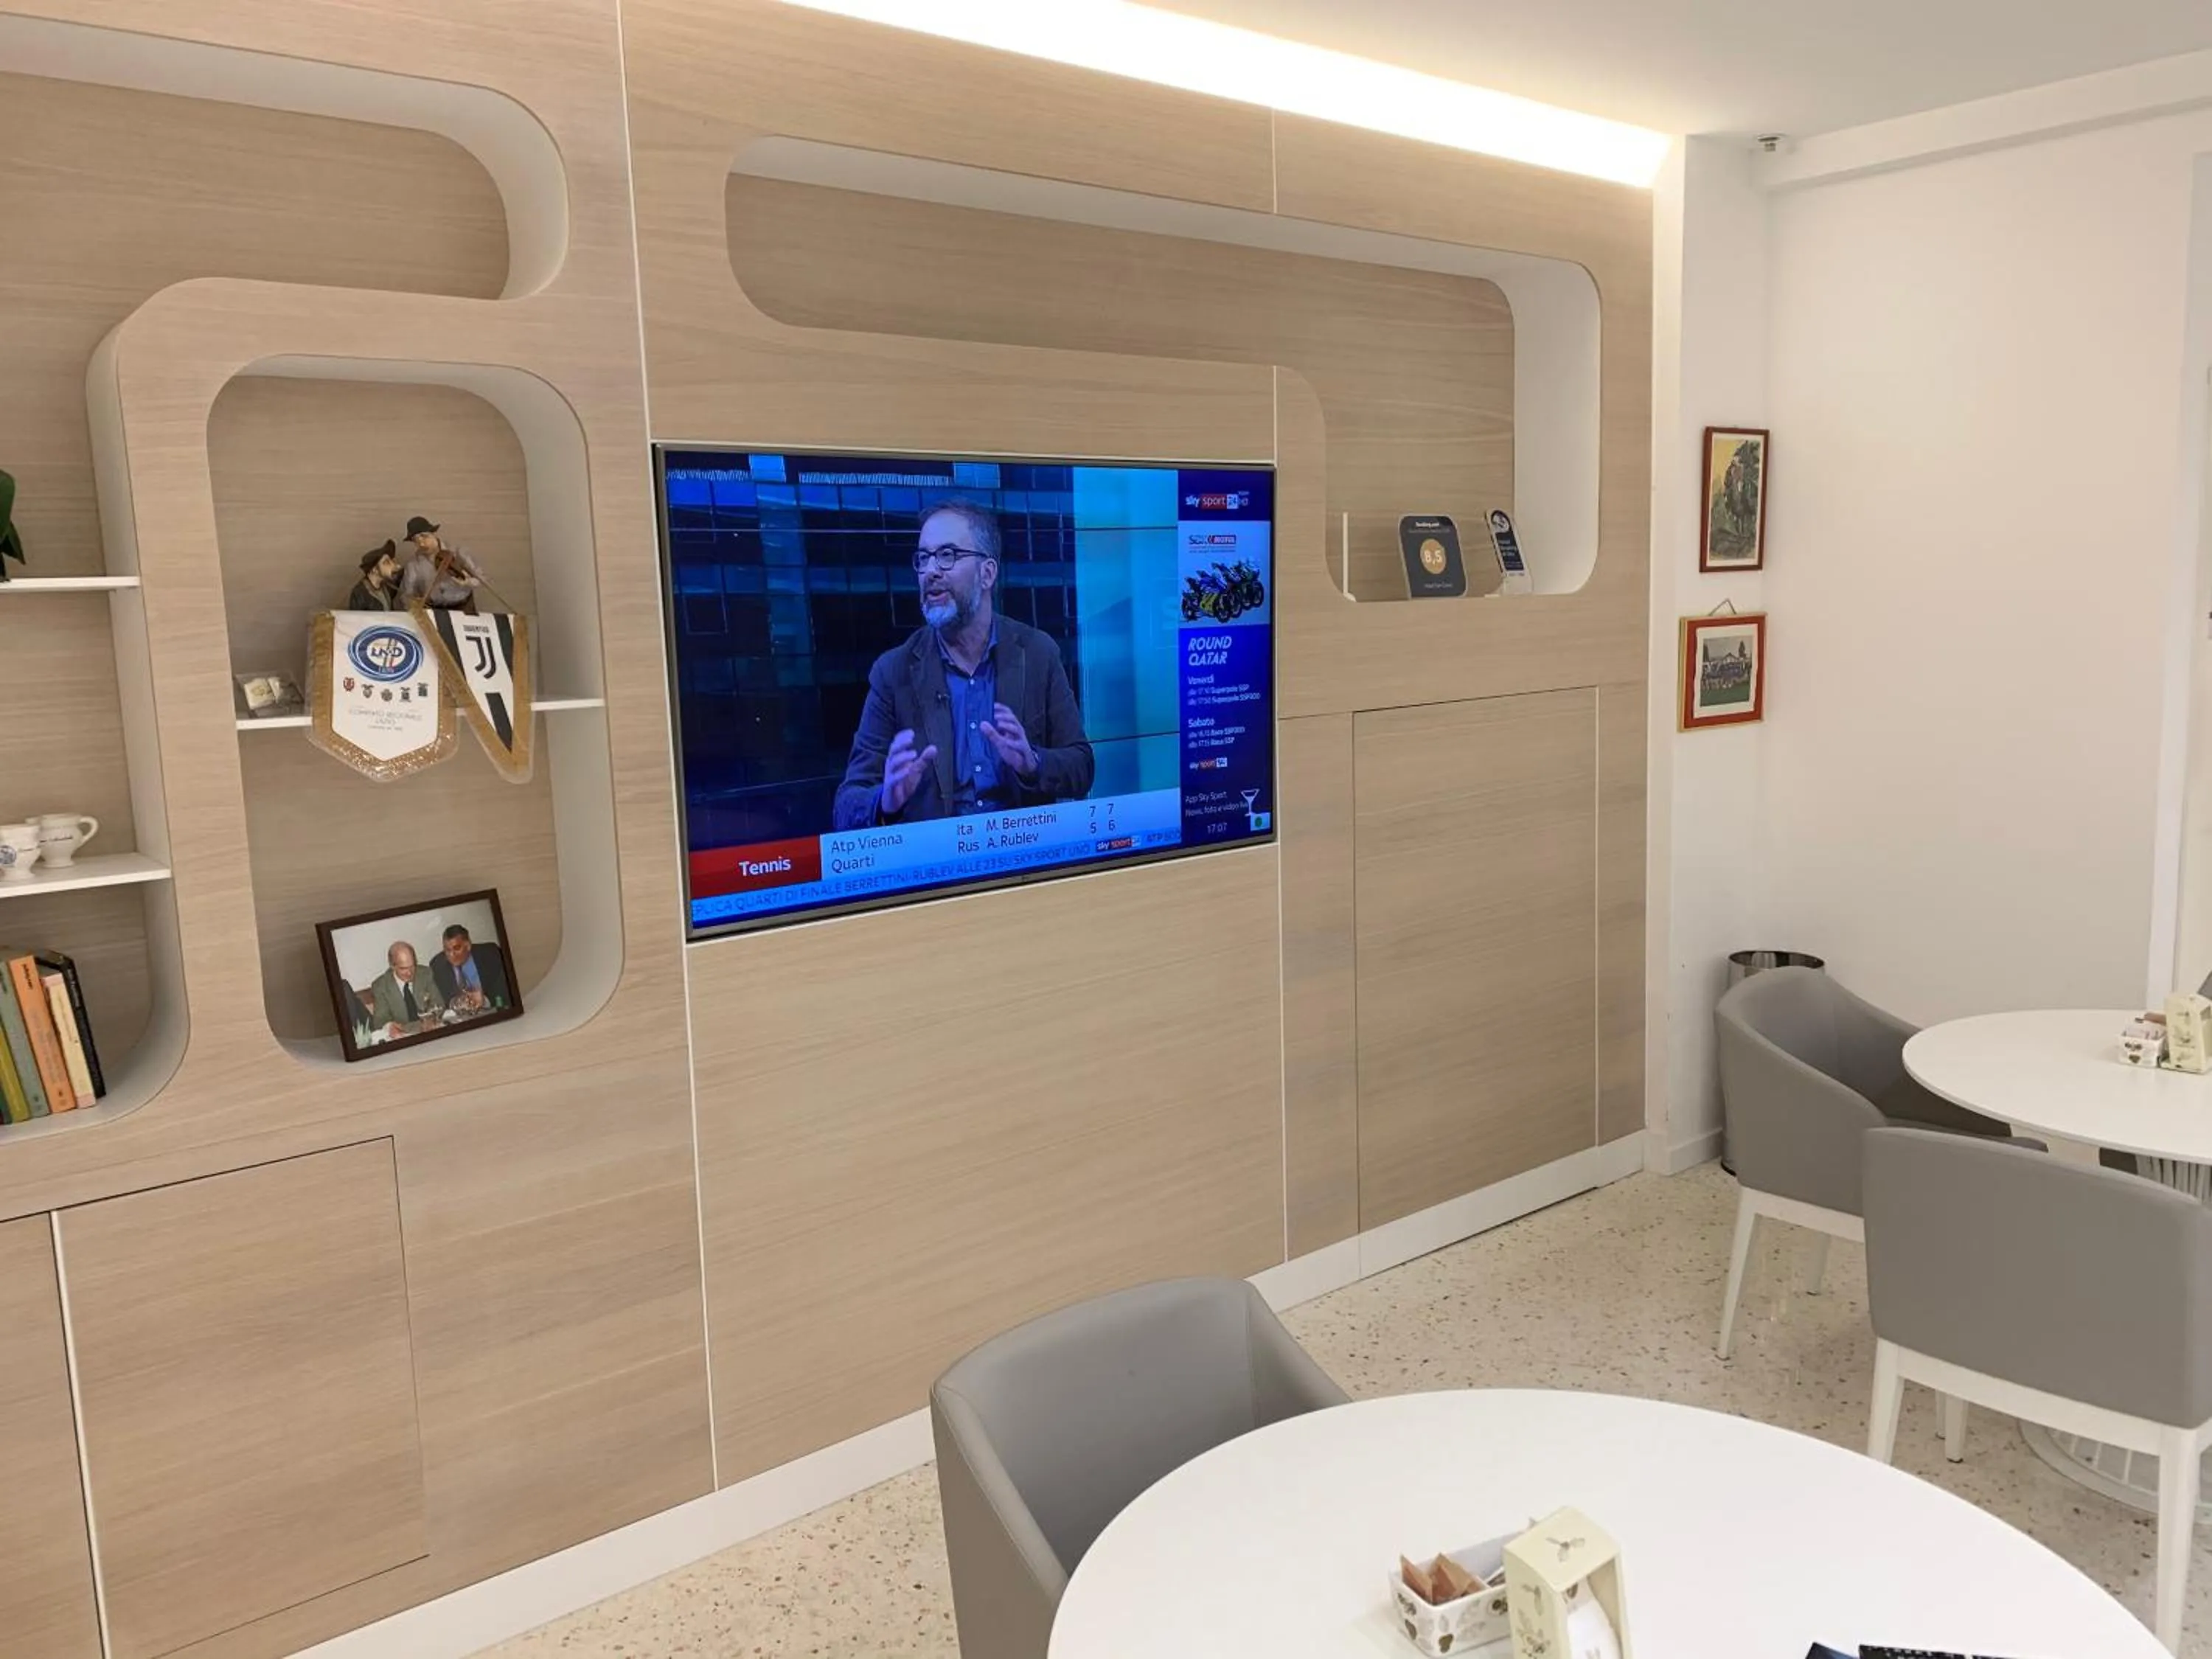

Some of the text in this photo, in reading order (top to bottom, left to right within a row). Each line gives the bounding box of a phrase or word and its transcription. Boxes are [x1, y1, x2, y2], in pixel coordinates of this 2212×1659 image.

[1188, 636, 1232, 651] ROUND
[1189, 651, 1227, 666] QATAR
[1002, 811, 1057, 830] Berrettini
[1090, 805, 1096, 818] 7
[1108, 803, 1115, 815] 7
[1090, 819, 1116, 834] 5 6
[831, 832, 903, 854] Atp Vienna
[958, 841, 980, 854] Rus
[1001, 832, 1040, 847] Rublev
[1096, 840, 1109, 851] sky
[739, 855, 792, 877] Tennis
[831, 854, 875, 874] Quarti
[734, 891, 781, 911] QUARTI
[785, 889, 798, 901] DI
[801, 883, 841, 898] FINALE
[959, 860, 981, 874] ALLE
[1014, 852, 1032, 866] SKY
[1034, 847, 1066, 862] SPORT
